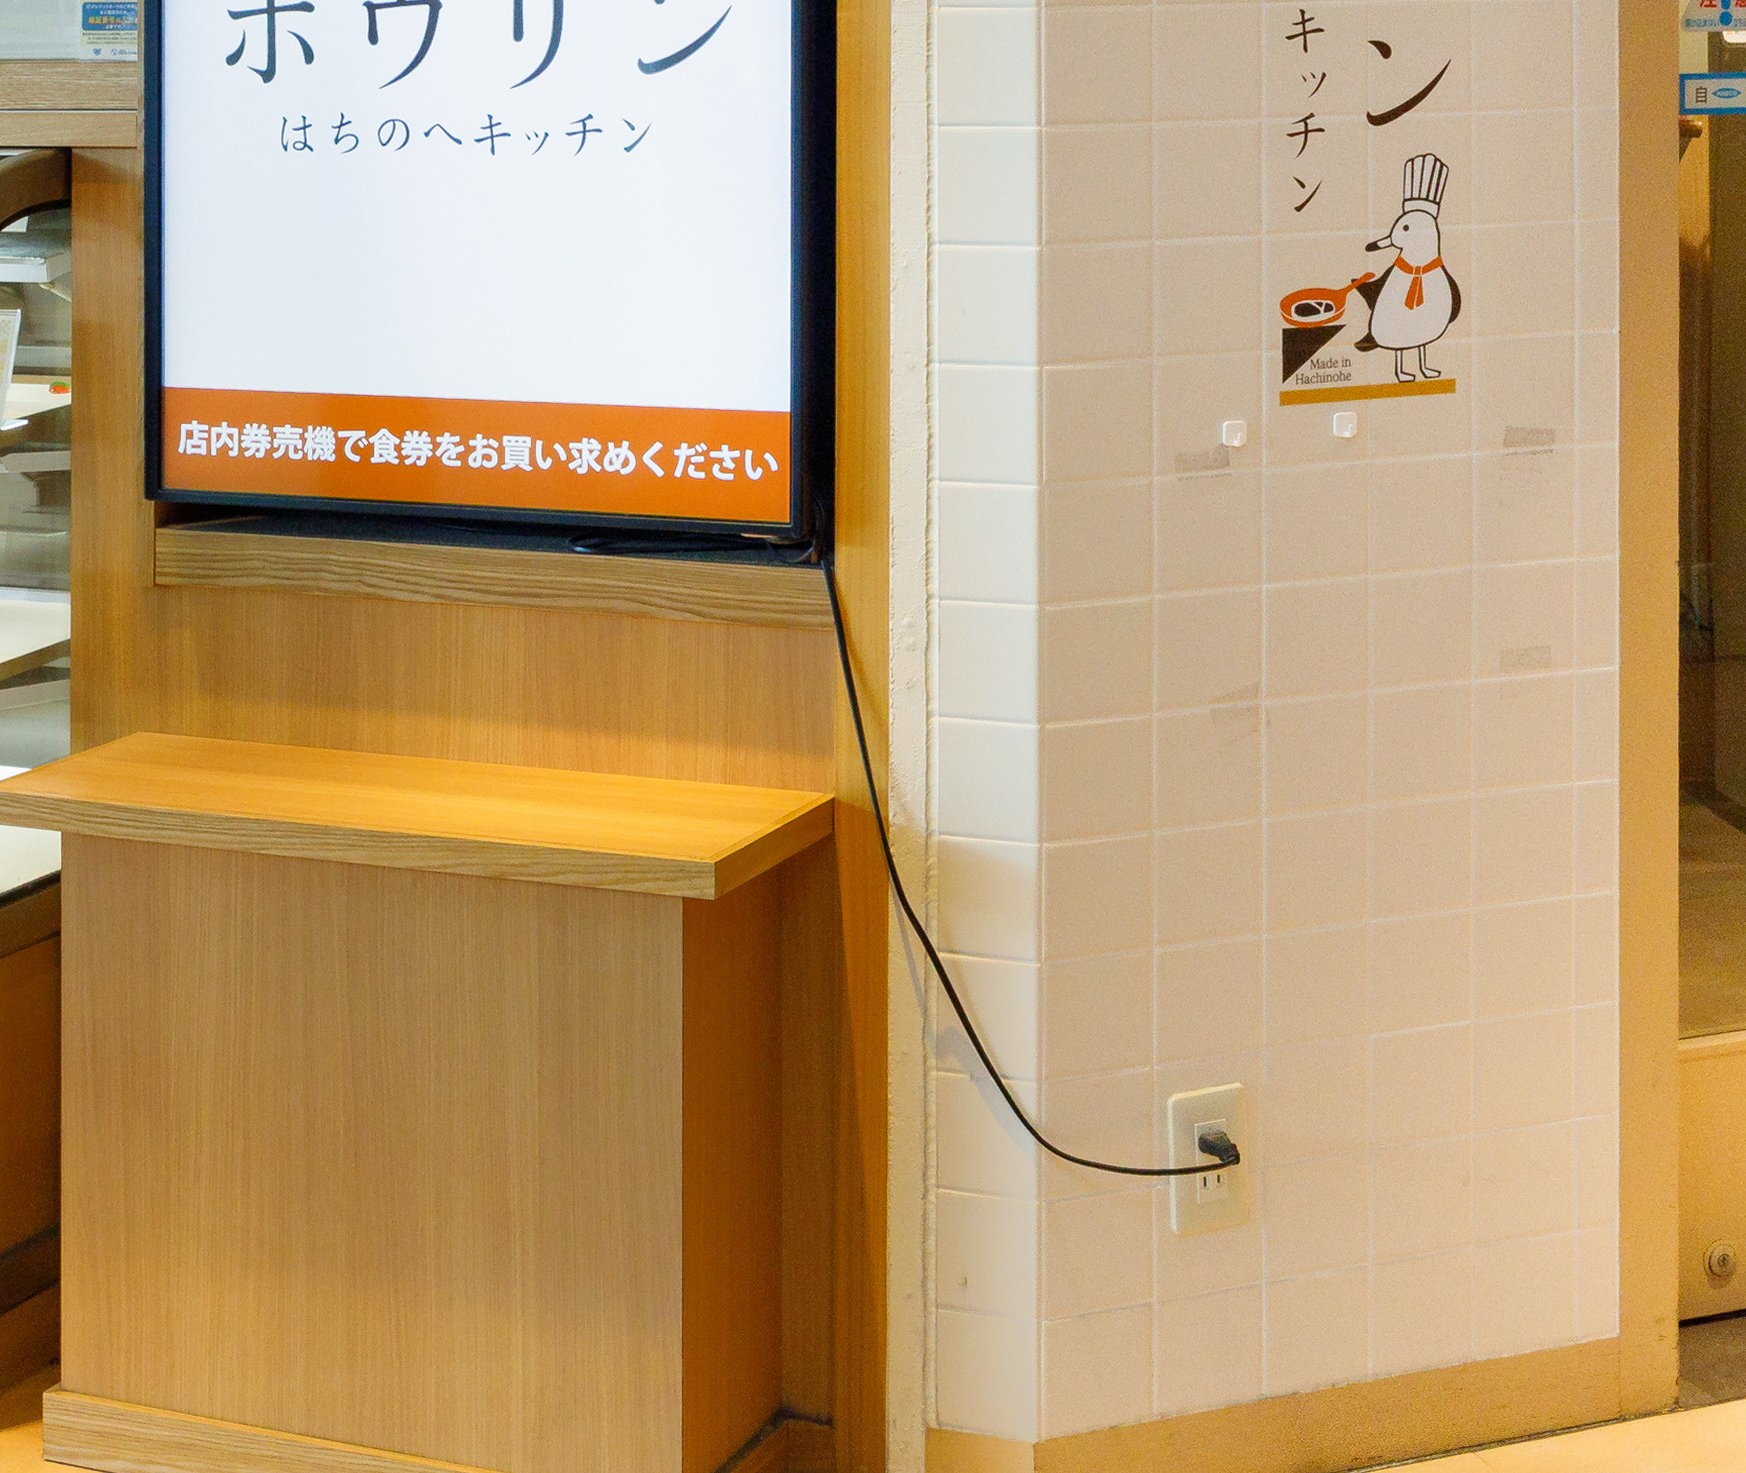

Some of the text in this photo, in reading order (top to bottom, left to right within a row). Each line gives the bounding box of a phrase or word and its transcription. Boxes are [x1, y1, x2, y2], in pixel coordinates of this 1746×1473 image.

[279, 113, 654, 159] はちのへキッチン
[1295, 371, 1353, 386] Hachinohe
[1309, 356, 1352, 371] Made in
[177, 419, 781, 484] 店内券売機で食券をお買い求めください
